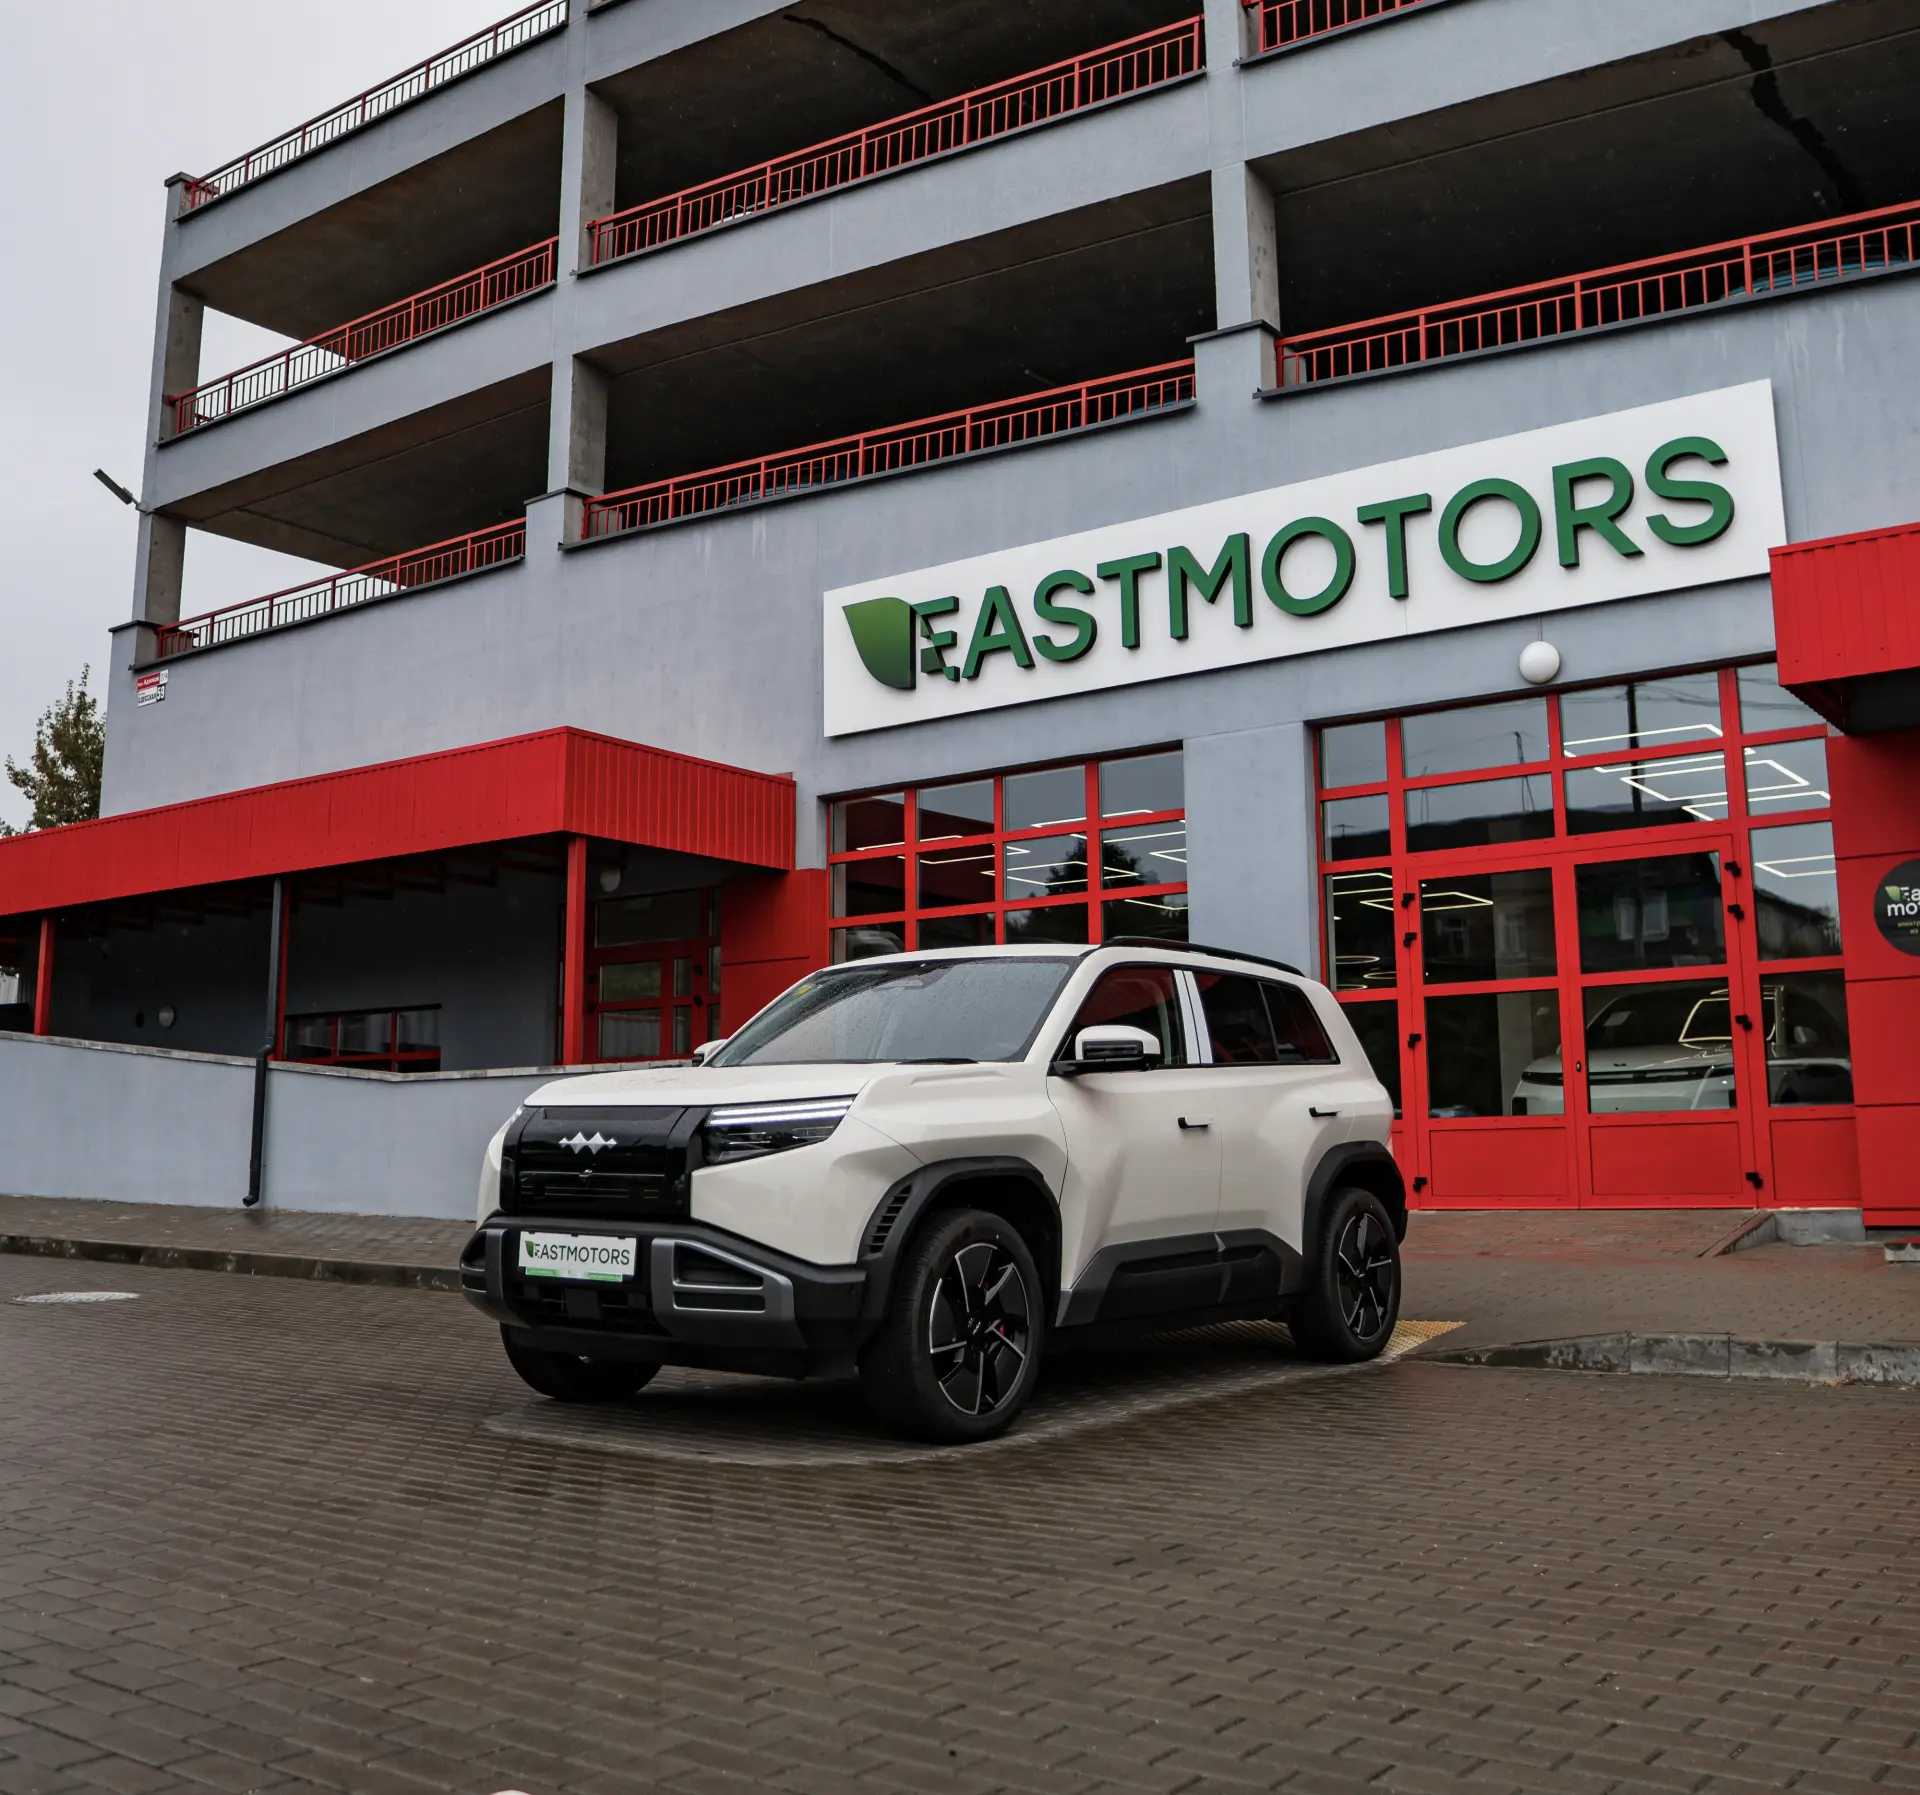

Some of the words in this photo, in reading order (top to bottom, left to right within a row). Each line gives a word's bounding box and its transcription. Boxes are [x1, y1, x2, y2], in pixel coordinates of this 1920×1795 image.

[909, 436, 1735, 682] EASTMOTORS
[157, 685, 165, 700] 59
[1887, 901, 1920, 917] mo
[534, 1243, 630, 1265] EASTMOTORS
